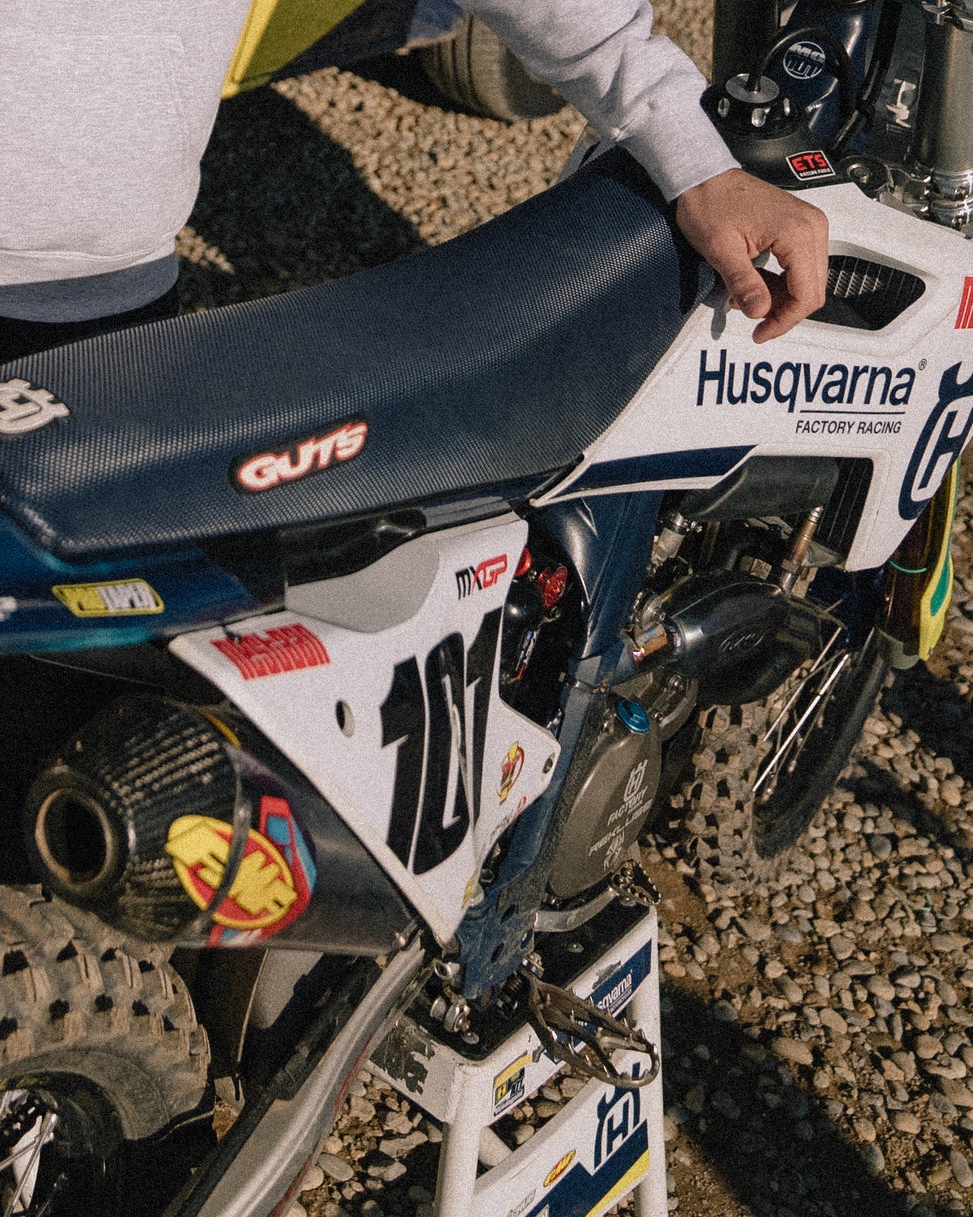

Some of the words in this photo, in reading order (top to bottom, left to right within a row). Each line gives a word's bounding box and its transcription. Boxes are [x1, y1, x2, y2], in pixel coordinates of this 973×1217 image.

[791, 153, 827, 171] ETS
[696, 349, 917, 413] Husqvarna
[237, 422, 369, 492] GUTS
[795, 420, 855, 434] FACTORY
[856, 420, 902, 434] RACING
[380, 605, 503, 875] 101
